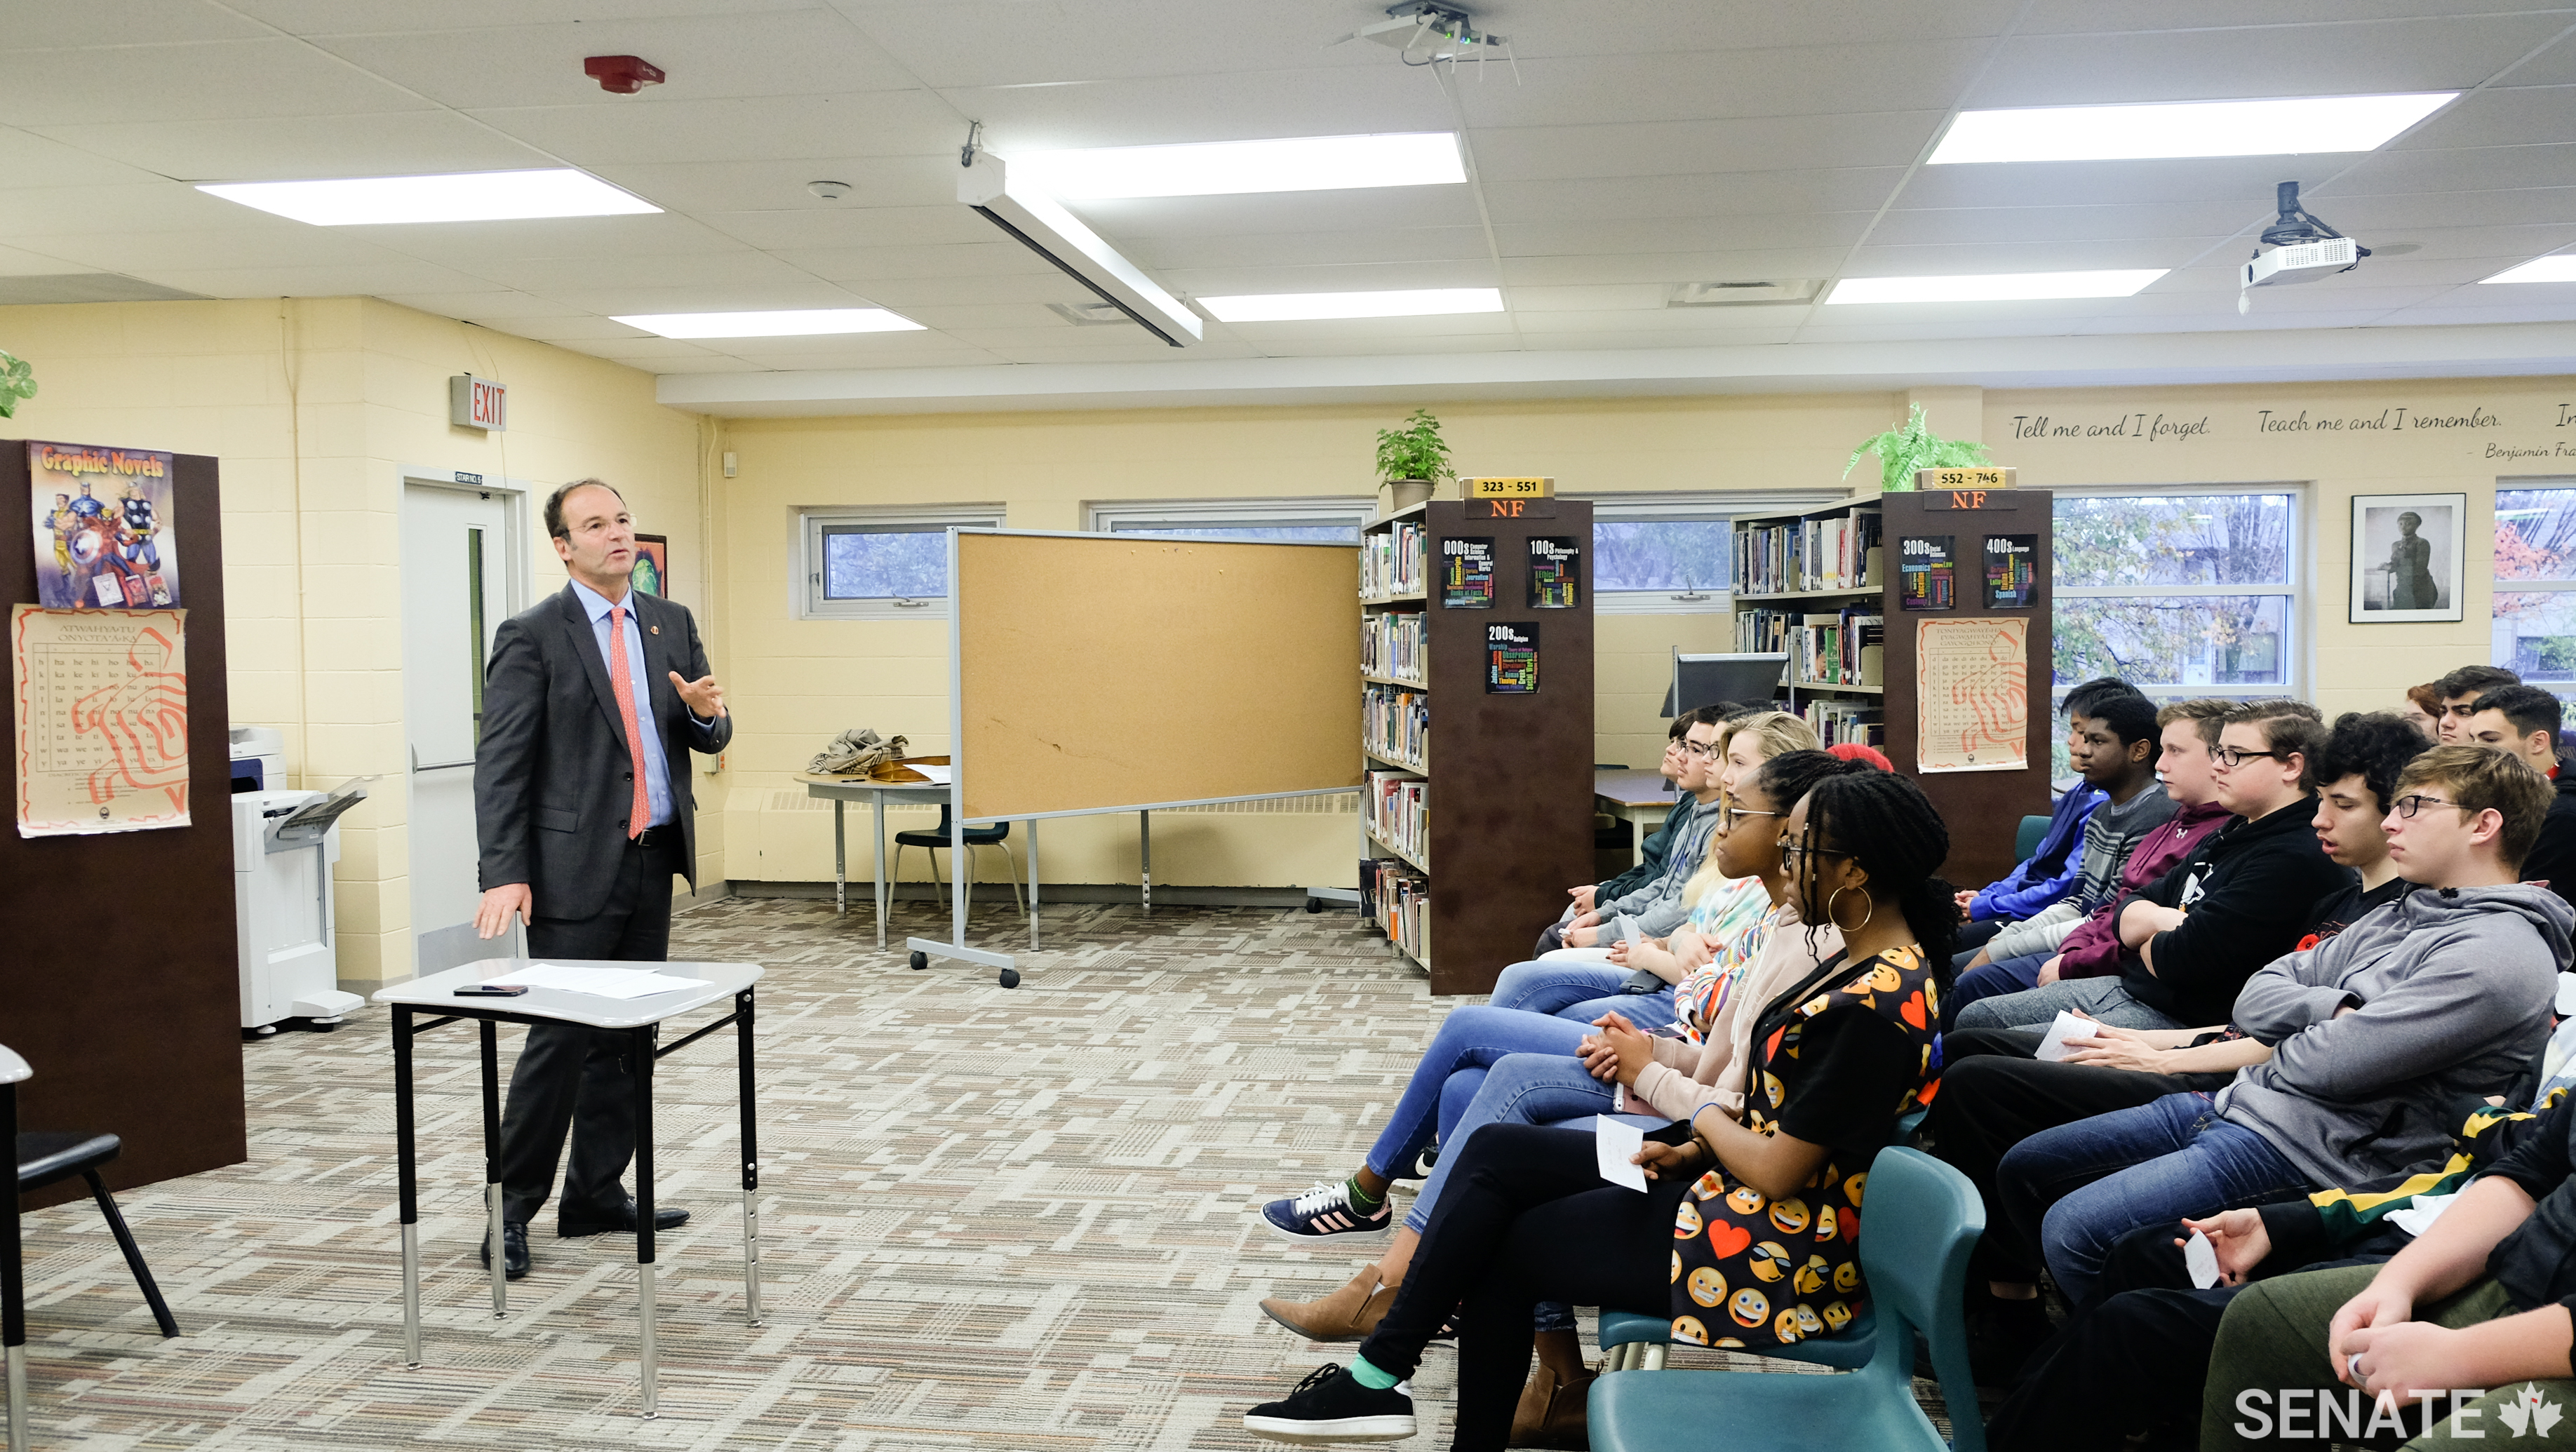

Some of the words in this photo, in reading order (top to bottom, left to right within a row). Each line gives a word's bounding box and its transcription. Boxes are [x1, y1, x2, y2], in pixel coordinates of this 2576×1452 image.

[474, 382, 504, 426] EXIT
[2053, 424, 2081, 437] me
[2087, 415, 2128, 437] and
[2131, 414, 2147, 437] I
[2149, 414, 2211, 441] forget.
[2258, 410, 2312, 433] Teach
[2316, 418, 2344, 431] me
[2349, 408, 2388, 431] and
[2392, 408, 2407, 431] I
[2413, 407, 2502, 429] remember.
[2485, 442, 2550, 462] Benjamin
[41, 446, 108, 476] Graphic
[111, 451, 164, 478] Novels
[1941, 473, 1964, 484] 552
[1975, 472, 1998, 483] 746
[1482, 481, 1504, 492] 323
[1517, 481, 1537, 492] 551
[1951, 491, 1987, 509] NF
[1490, 500, 1526, 518] NF
[1444, 540, 1470, 555] 000s
[1530, 540, 1555, 555] 100s
[1903, 539, 1930, 555] 300s
[1987, 538, 2013, 553] 400s
[1902, 563, 1931, 572] Economics
[1917, 572, 1925, 598] Education
[1995, 590, 2017, 600] Spanish
[1489, 626, 1514, 640] 200s
